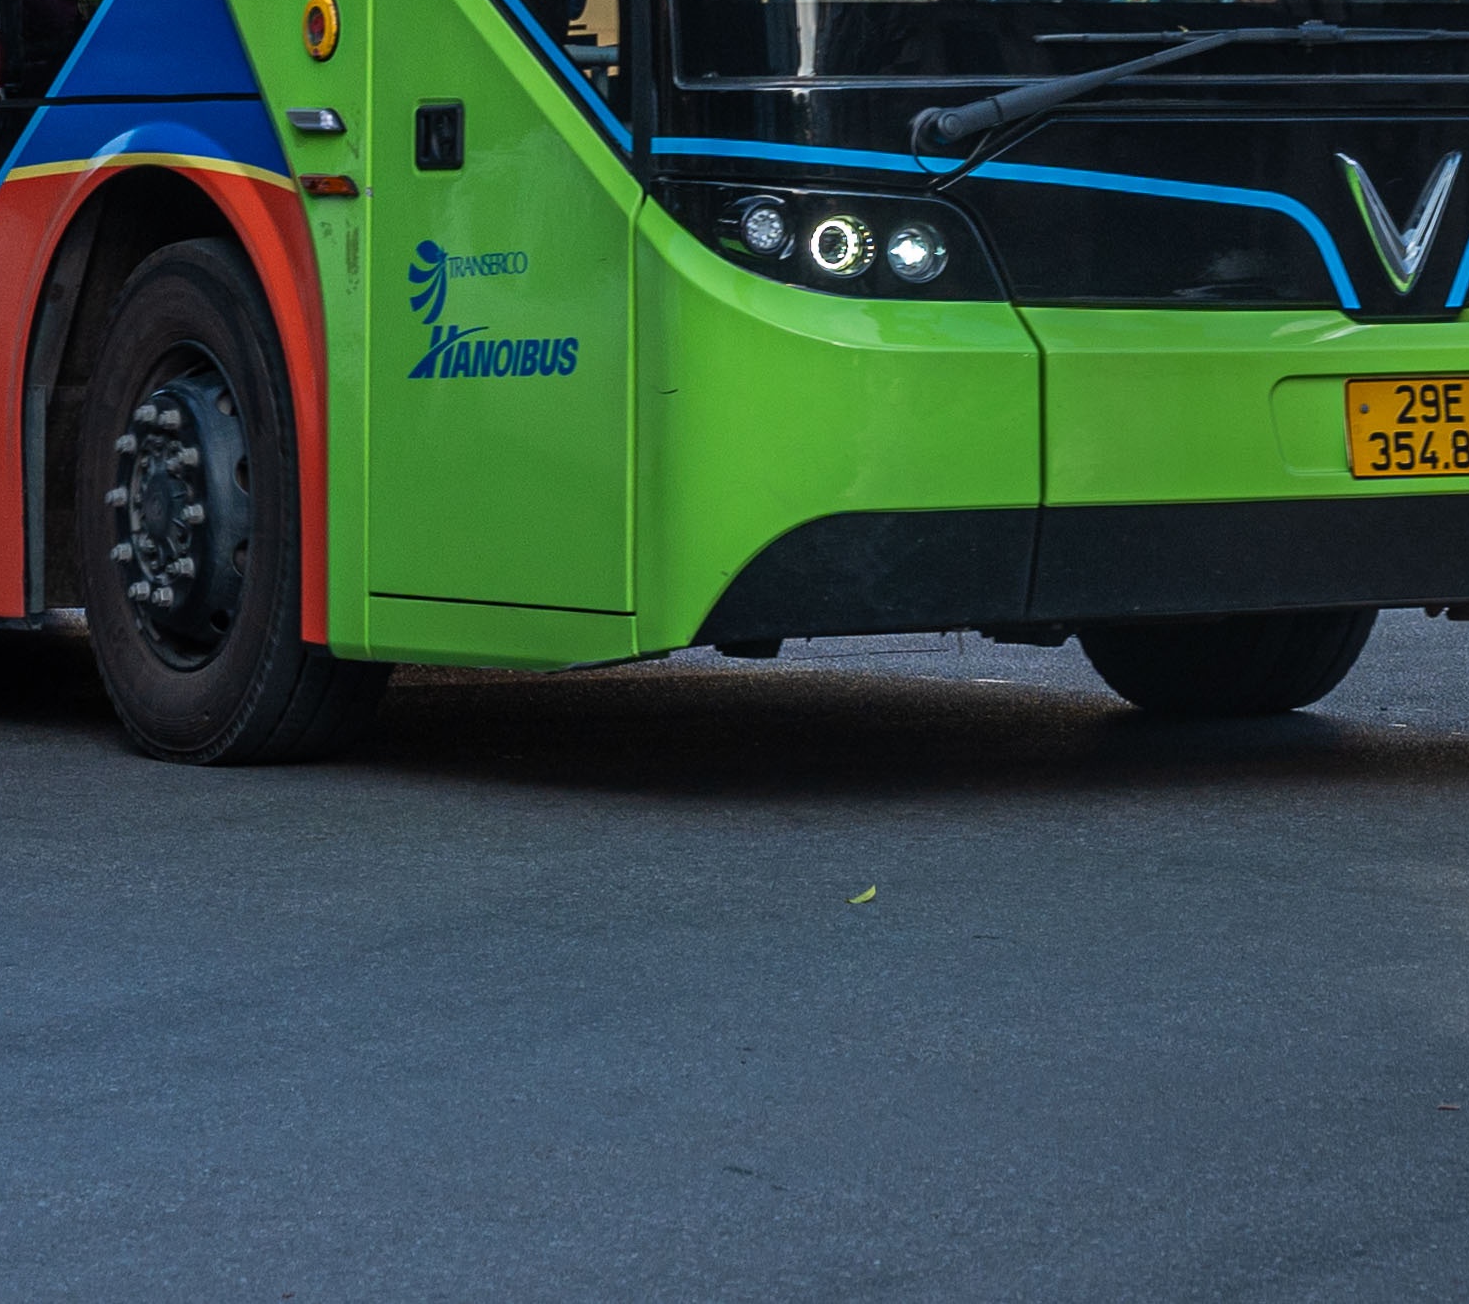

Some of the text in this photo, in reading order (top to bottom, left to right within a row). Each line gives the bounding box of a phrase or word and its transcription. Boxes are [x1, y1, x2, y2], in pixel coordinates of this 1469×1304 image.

[448, 251, 528, 279] TRANSERCO
[407, 325, 579, 379] HANOIBUS
[1395, 383, 1466, 425] 29E
